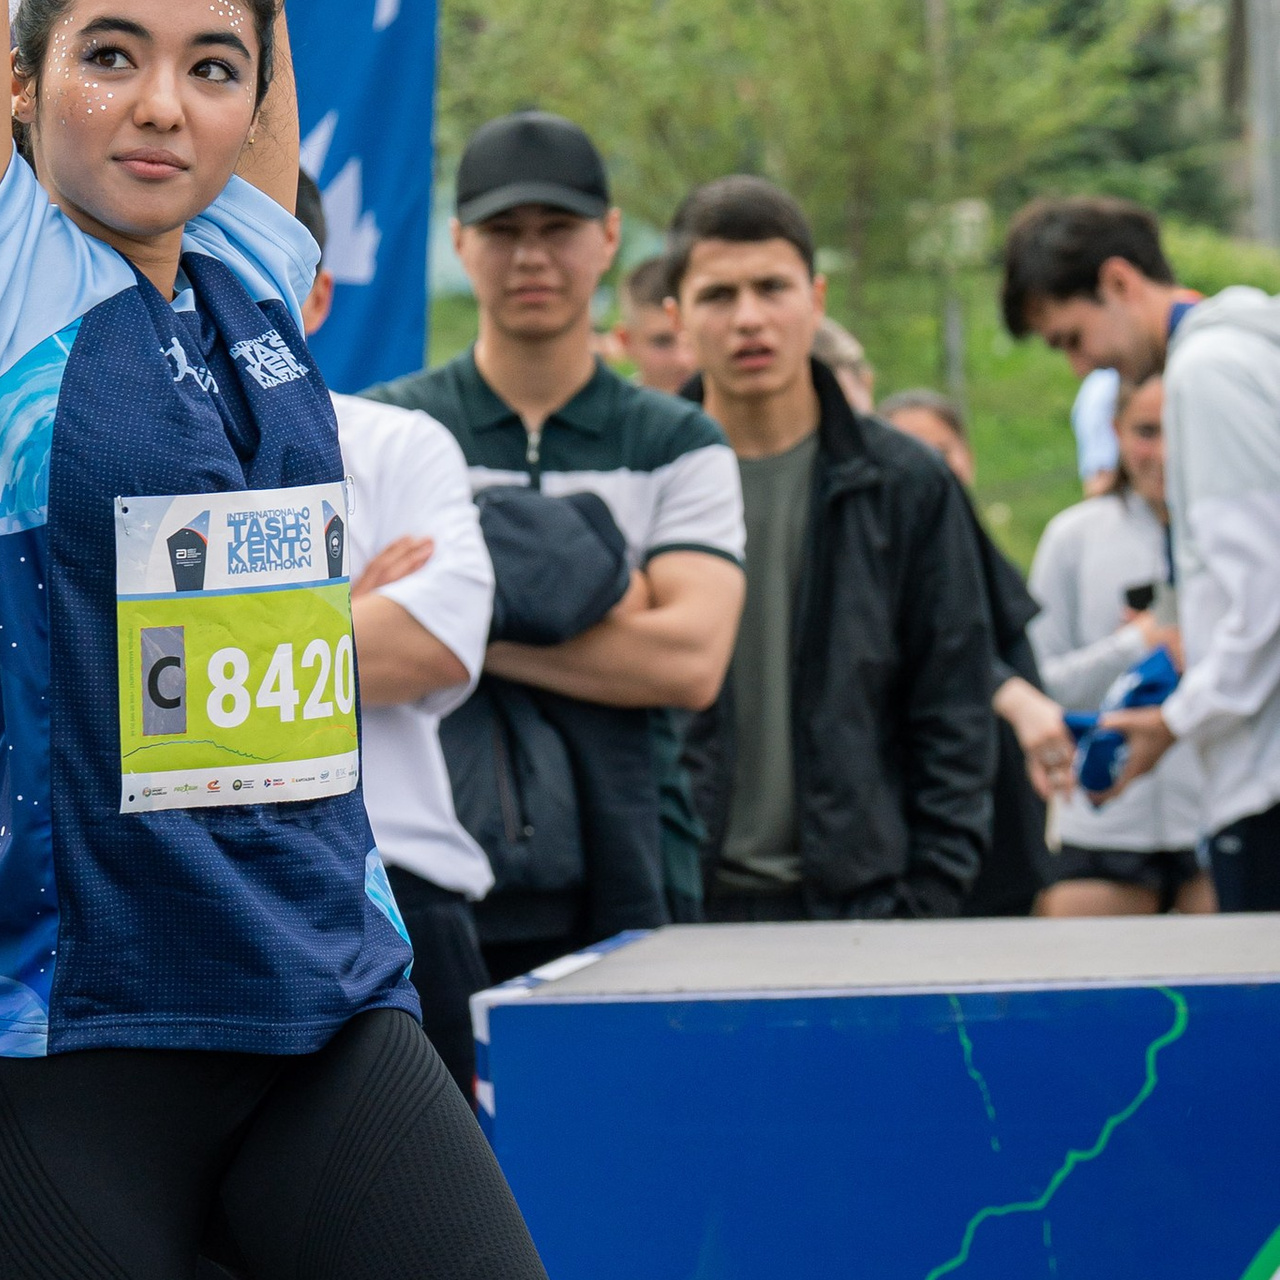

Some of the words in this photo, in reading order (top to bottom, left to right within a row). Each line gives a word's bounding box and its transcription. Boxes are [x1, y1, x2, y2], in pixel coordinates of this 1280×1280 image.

[227, 513, 302, 543] TASH
[228, 536, 300, 565] KENT
[228, 559, 300, 575] MARATHON
[148, 656, 181, 709] C
[206, 634, 354, 728] 8420
